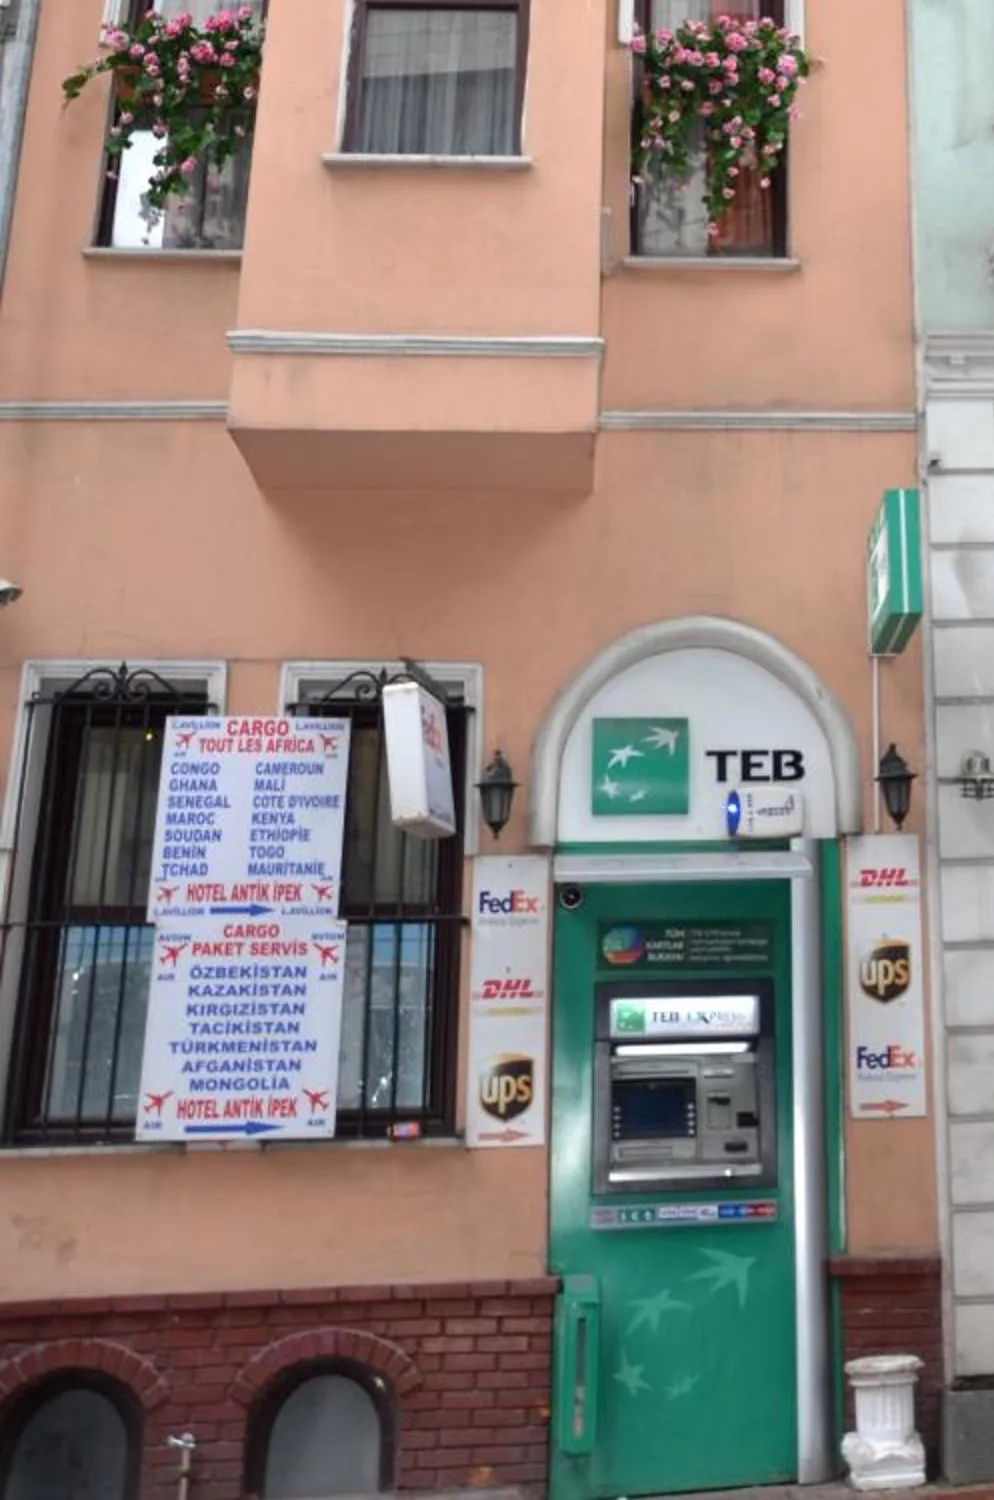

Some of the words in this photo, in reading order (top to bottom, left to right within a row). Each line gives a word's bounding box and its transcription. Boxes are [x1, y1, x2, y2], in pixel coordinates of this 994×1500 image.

[227, 719, 289, 736] CARGO
[200, 738, 233, 753] TOUT
[238, 738, 262, 753] LES
[170, 761, 221, 775] CONGO
[255, 761, 324, 775] CAMEROUN
[705, 749, 806, 783] TEB
[169, 778, 218, 792] GHANA
[167, 795, 231, 809] SENEGAL
[252, 795, 287, 809] COTE
[165, 812, 215, 825] MAROC
[250, 812, 296, 826] KENYA
[164, 829, 222, 843] SOUDAN
[249, 845, 285, 859] TOGO
[161, 862, 209, 877] TCHAD
[859, 868, 910, 888] DHL
[187, 884, 227, 902] HOTEL
[479, 889, 538, 914] FedEx
[223, 923, 281, 938] CARGO
[191, 942, 243, 956] PAKET
[862, 959, 909, 995] ups
[481, 979, 535, 999] DHL
[856, 1045, 916, 1070] FedEx
[482, 1076, 532, 1113] ups
[176, 1099, 220, 1119] HOTEL
